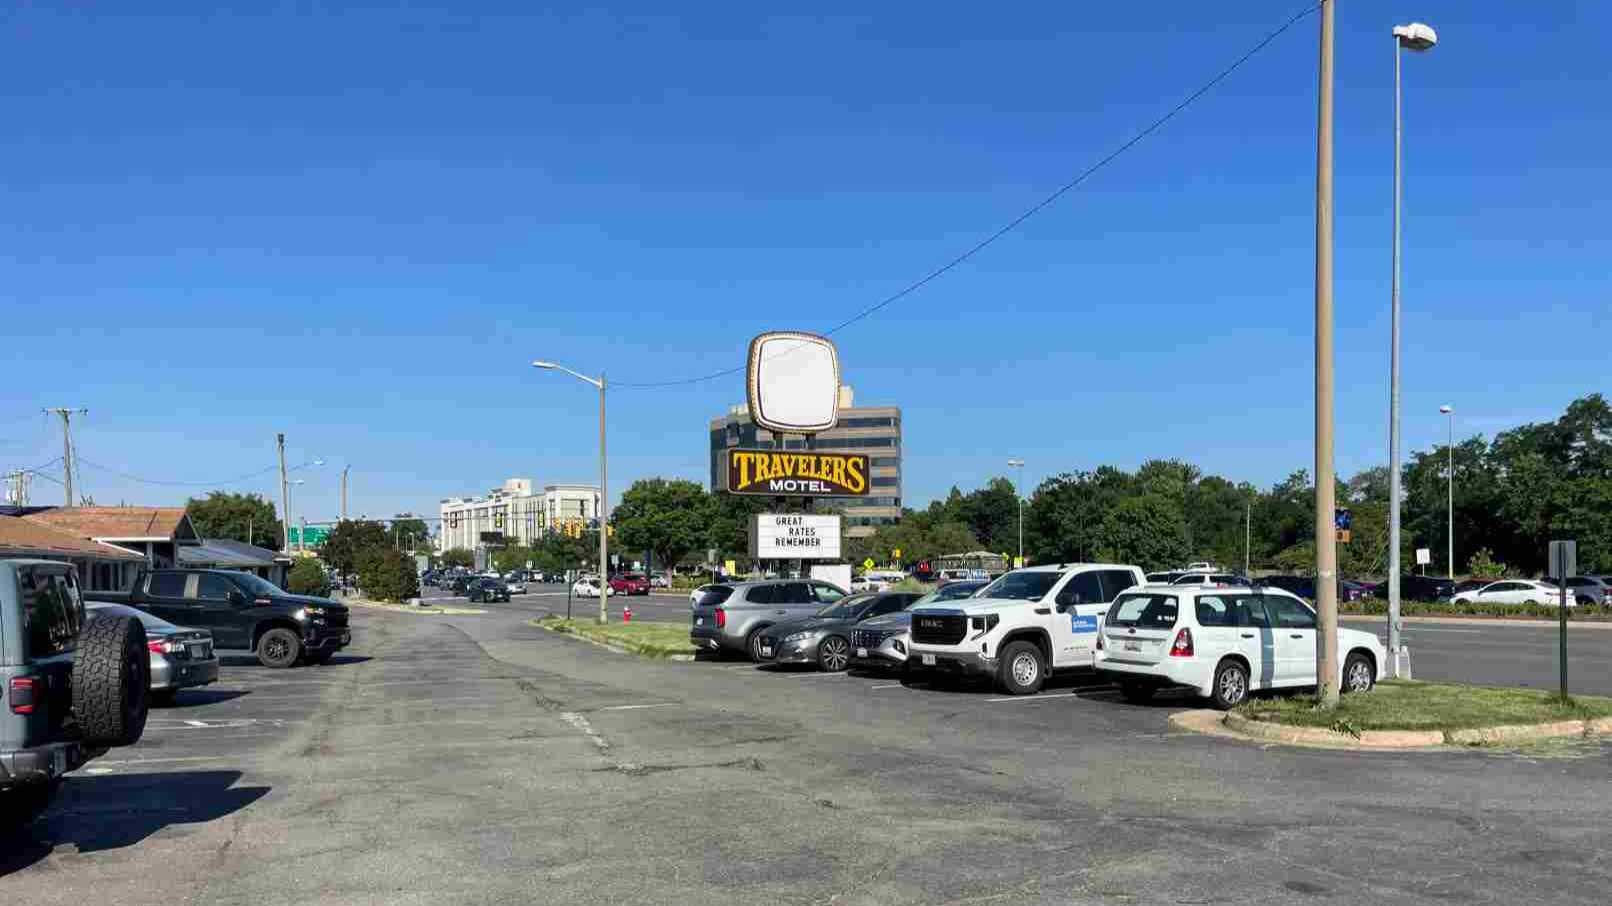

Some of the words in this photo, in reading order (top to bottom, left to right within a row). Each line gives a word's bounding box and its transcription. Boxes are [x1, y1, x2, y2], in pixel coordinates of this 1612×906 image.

[733, 452, 865, 493] TRAVELERS
[769, 480, 832, 492] MOTEL
[775, 516, 803, 526] GREAT
[788, 527, 816, 537] RATES
[775, 537, 821, 547] REMEMBER
